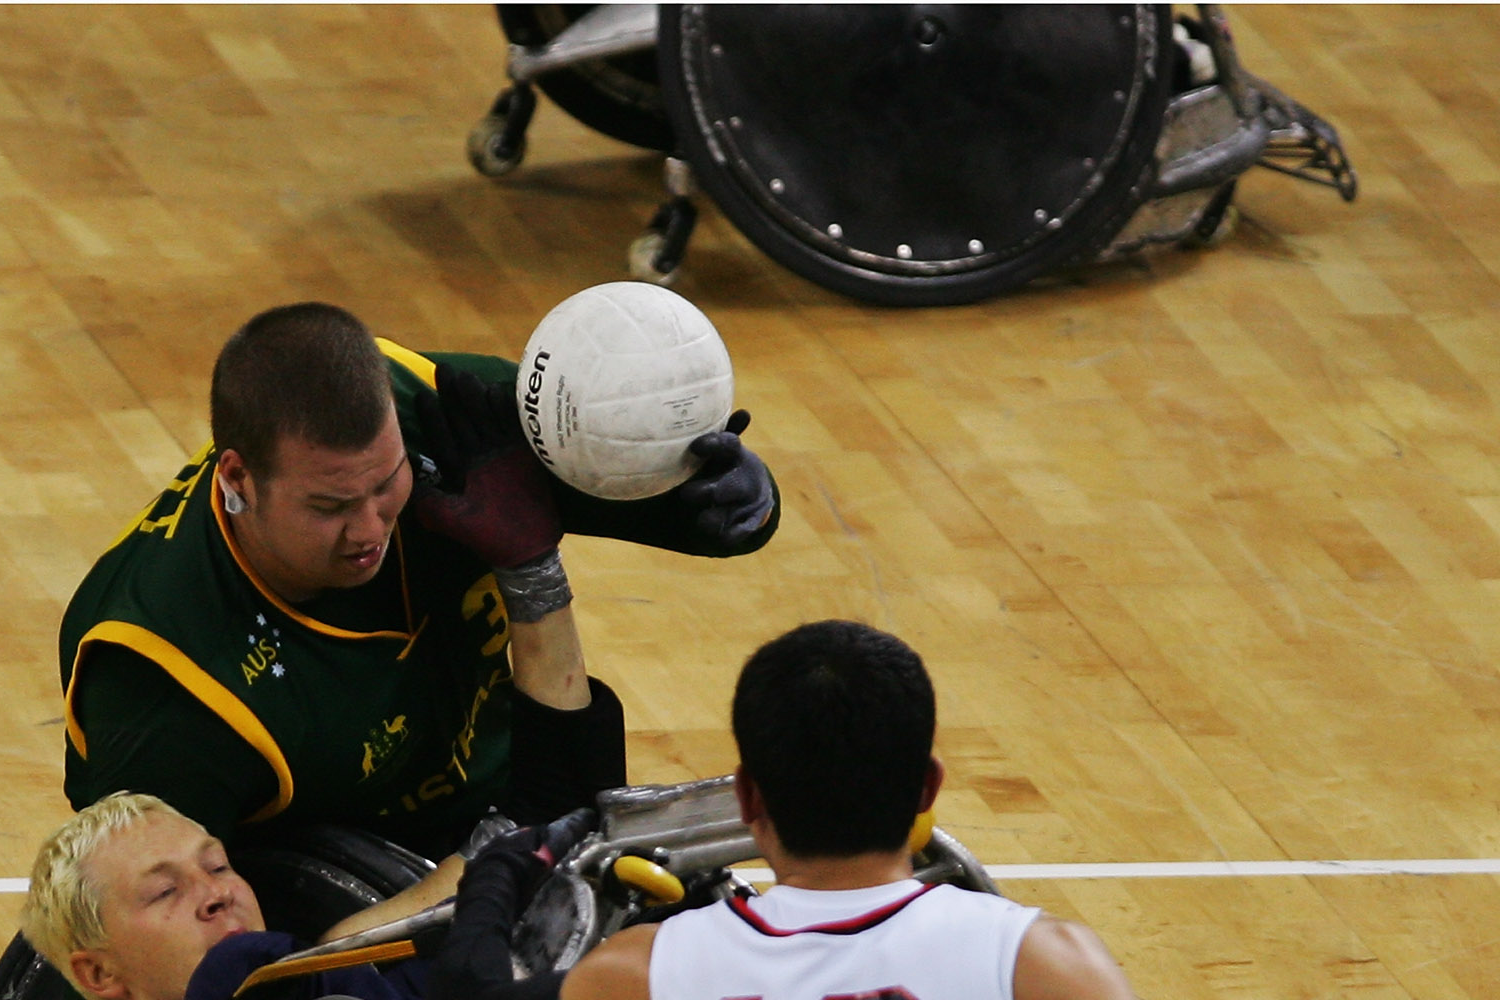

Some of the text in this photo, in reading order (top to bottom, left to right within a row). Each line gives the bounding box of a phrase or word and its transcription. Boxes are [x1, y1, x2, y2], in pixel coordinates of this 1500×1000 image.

[525, 351, 555, 466] molten
[461, 572, 510, 657] 3
[240, 637, 277, 685] AUS
